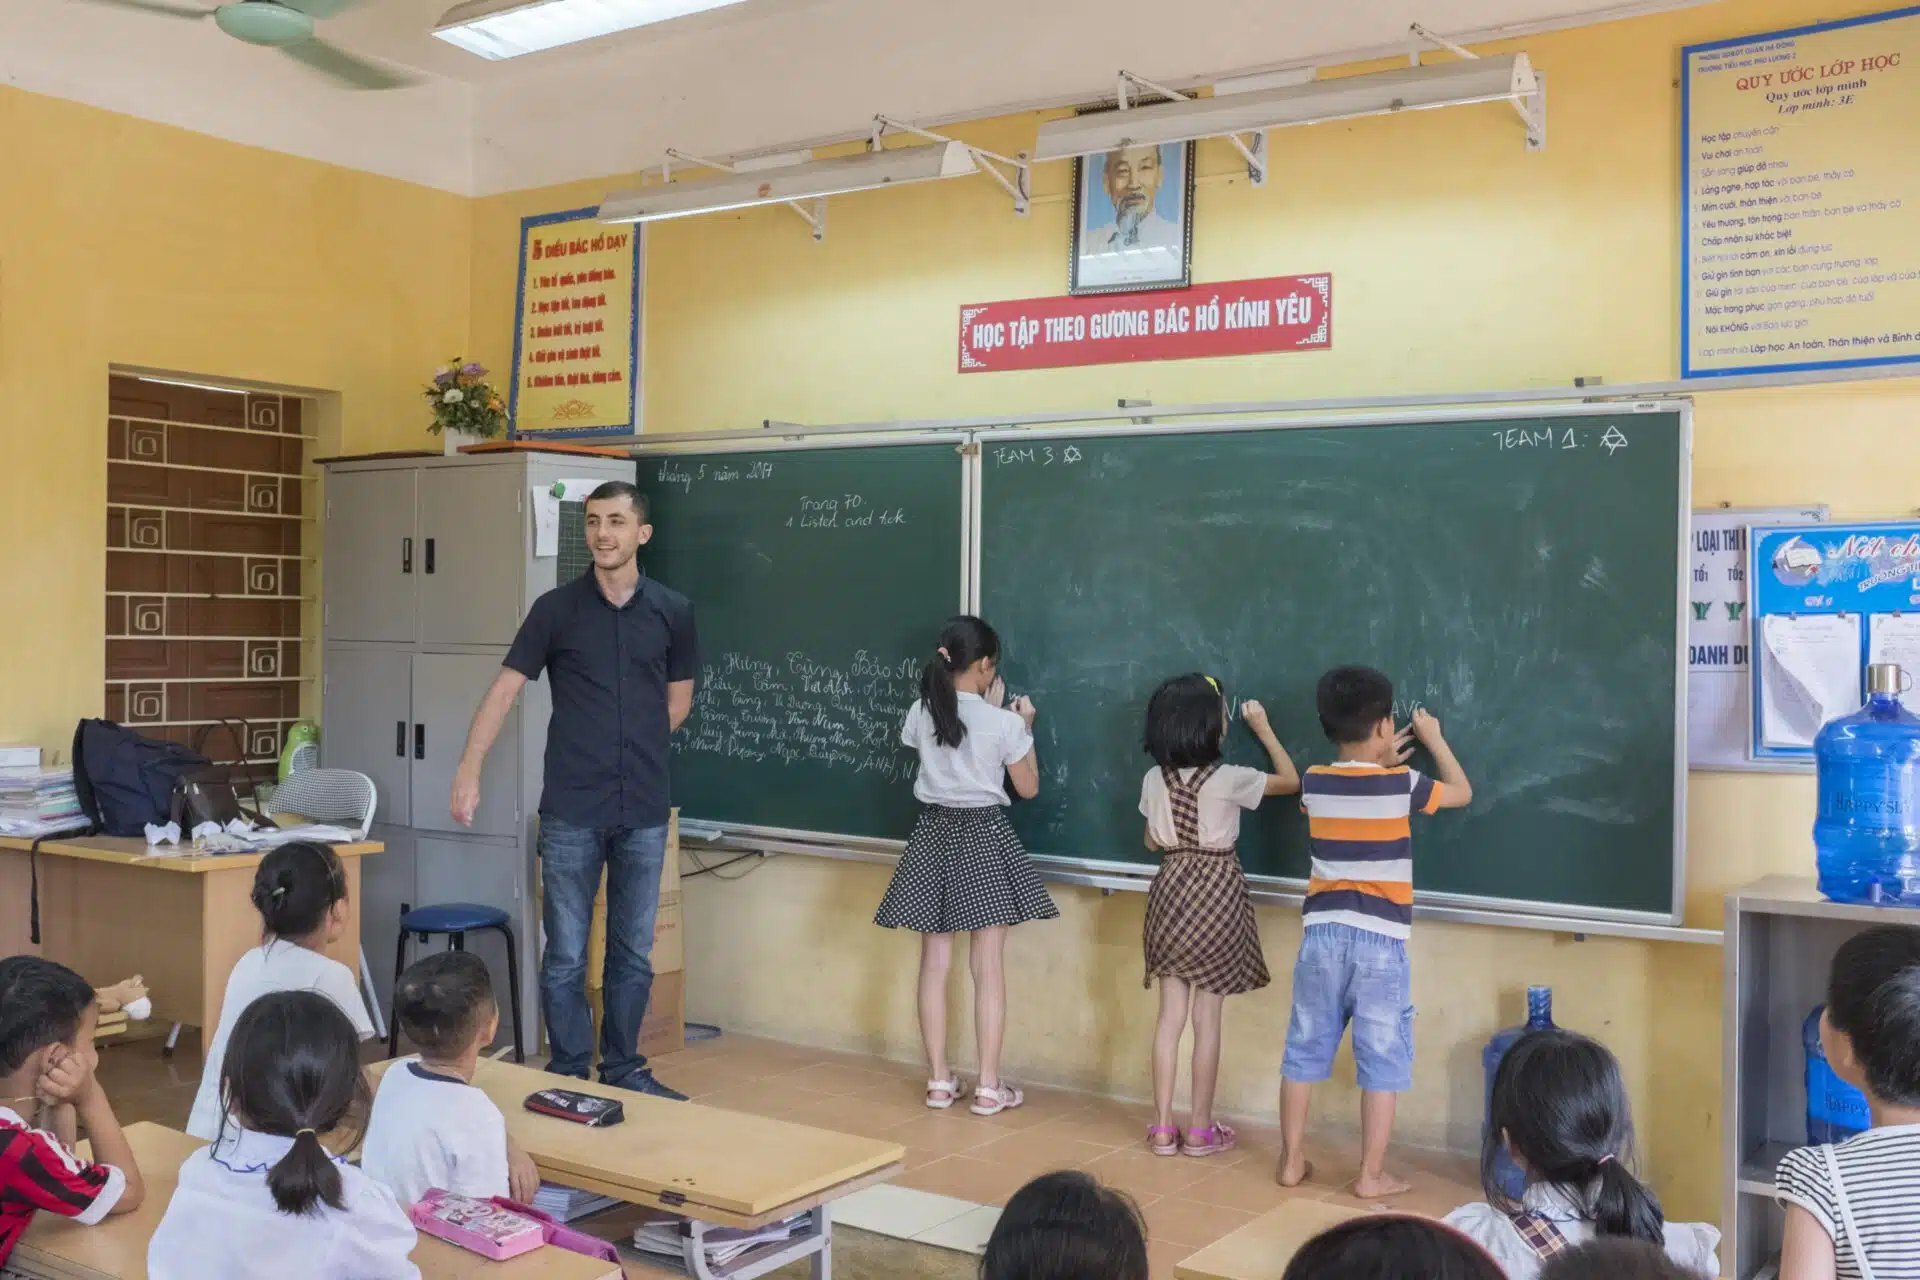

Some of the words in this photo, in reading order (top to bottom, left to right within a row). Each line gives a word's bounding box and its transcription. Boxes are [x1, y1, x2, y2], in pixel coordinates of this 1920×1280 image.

[1736, 73, 1773, 91] QUY
[1780, 65, 1814, 84] ƯỚC
[1820, 59, 1855, 79] LỚP
[1861, 53, 1901, 73] HỌC
[1766, 90, 1789, 103] Quy
[569, 236, 588, 256] BÁC
[973, 322, 1005, 352] HỌC
[1009, 316, 1039, 350] TẬP
[1045, 314, 1085, 342] THEO
[1090, 309, 1149, 340] GƯƠNG
[1154, 302, 1190, 335] BÁC
[1225, 296, 1270, 329] KÍNH
[1275, 292, 1312, 326] YÊU
[1788, 341, 1800, 351] An
[1493, 426, 1553, 451] TEAM
[993, 446, 1035, 469] TEAM
[713, 464, 741, 482] năm
[800, 510, 839, 528] Listen
[845, 509, 875, 527] and
[1696, 530, 1720, 556] LOẠI
[1722, 529, 1740, 552] THI
